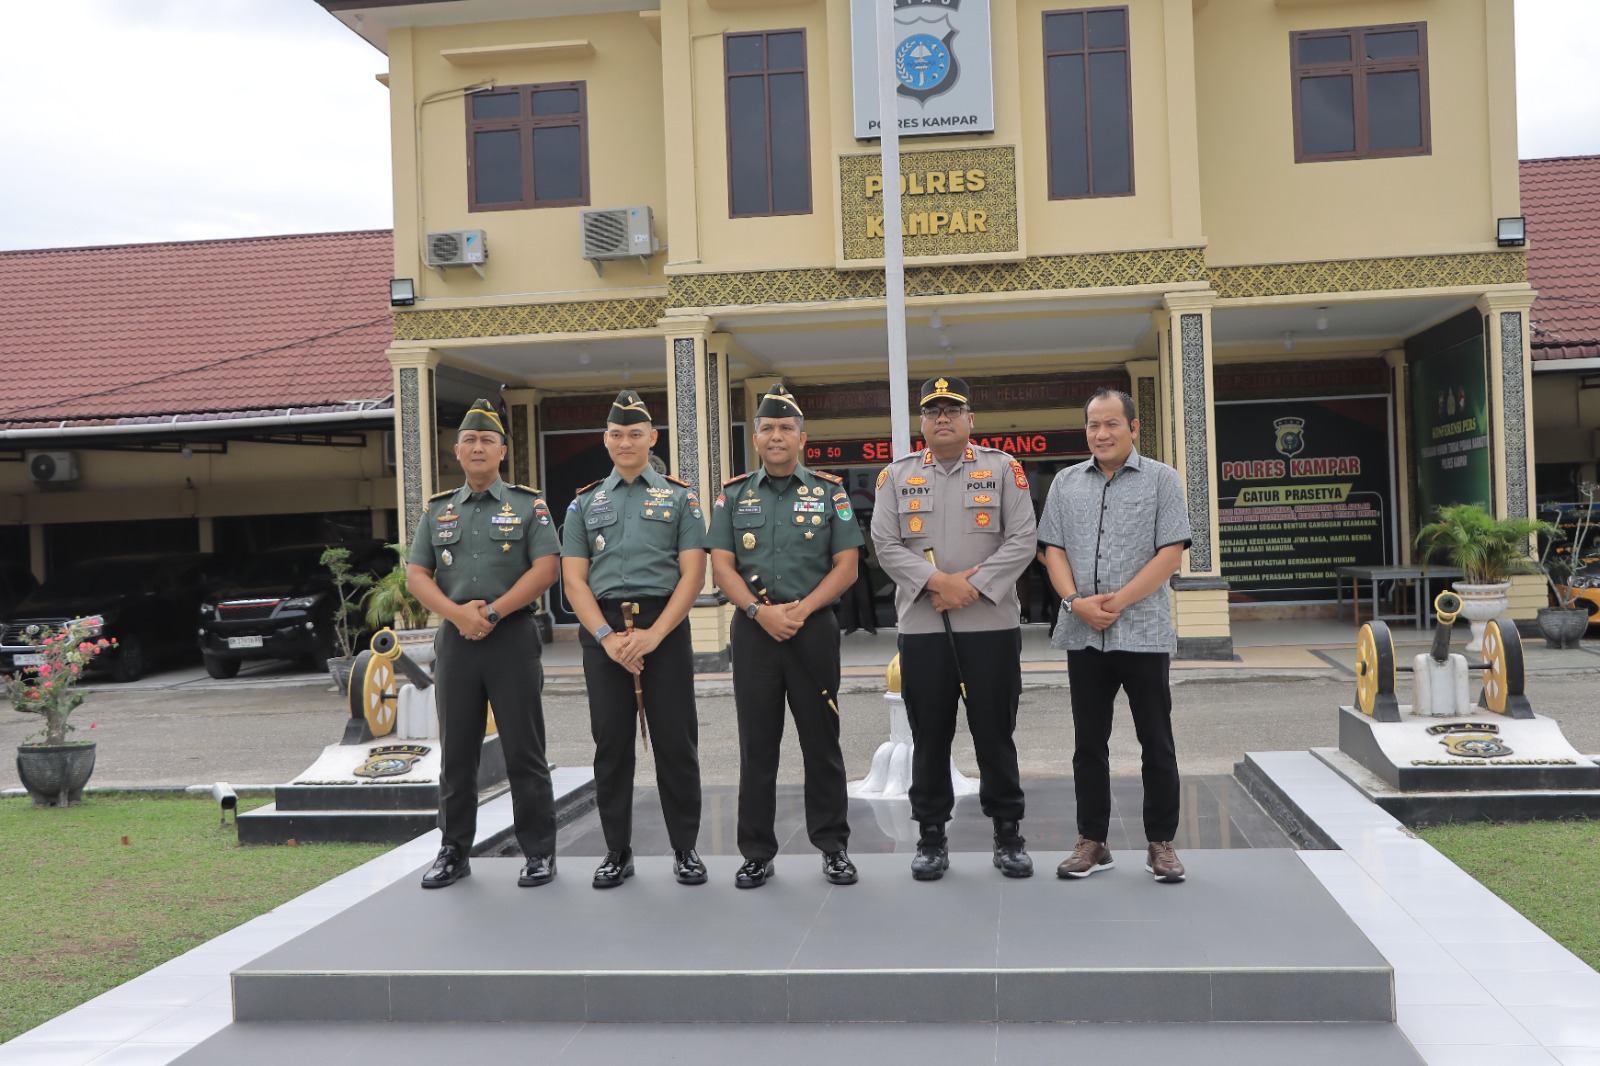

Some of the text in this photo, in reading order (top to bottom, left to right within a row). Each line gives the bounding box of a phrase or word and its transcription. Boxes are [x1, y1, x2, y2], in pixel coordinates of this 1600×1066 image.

[868, 115, 978, 130] PRES KAMPAR
[1462, 416, 1477, 432] PERS
[807, 447, 821, 459] 09
[827, 446, 841, 458] 50
[1222, 456, 1361, 480] POLRES KAMPAR
[901, 486, 931, 496] BOBY
[966, 481, 996, 491] POLRI
[1243, 487, 1343, 502] CATUR PRASETYA
[1283, 521, 1307, 529] BENTUK
[1308, 520, 1341, 528] GANGGUAN
[1219, 539, 1248, 547] MENJAGA
[1249, 537, 1292, 546] KESELAMATAN
[1293, 536, 1309, 544] JIWA
[1330, 534, 1350, 542] HARTA
[1351, 533, 1372, 541] BENDA
[1246, 545, 1264, 553] ASASI
[1265, 544, 1296, 552] MANUSIA.
[1220, 560, 1252, 568] MENJAMIN
[1287, 557, 1332, 565] BERDASARKAN
[1262, 572, 1294, 580] PERASAAN
[1294, 571, 1324, 579] TENTRAM
[1410, 758, 1577, 767] POLRES KAMPAR
